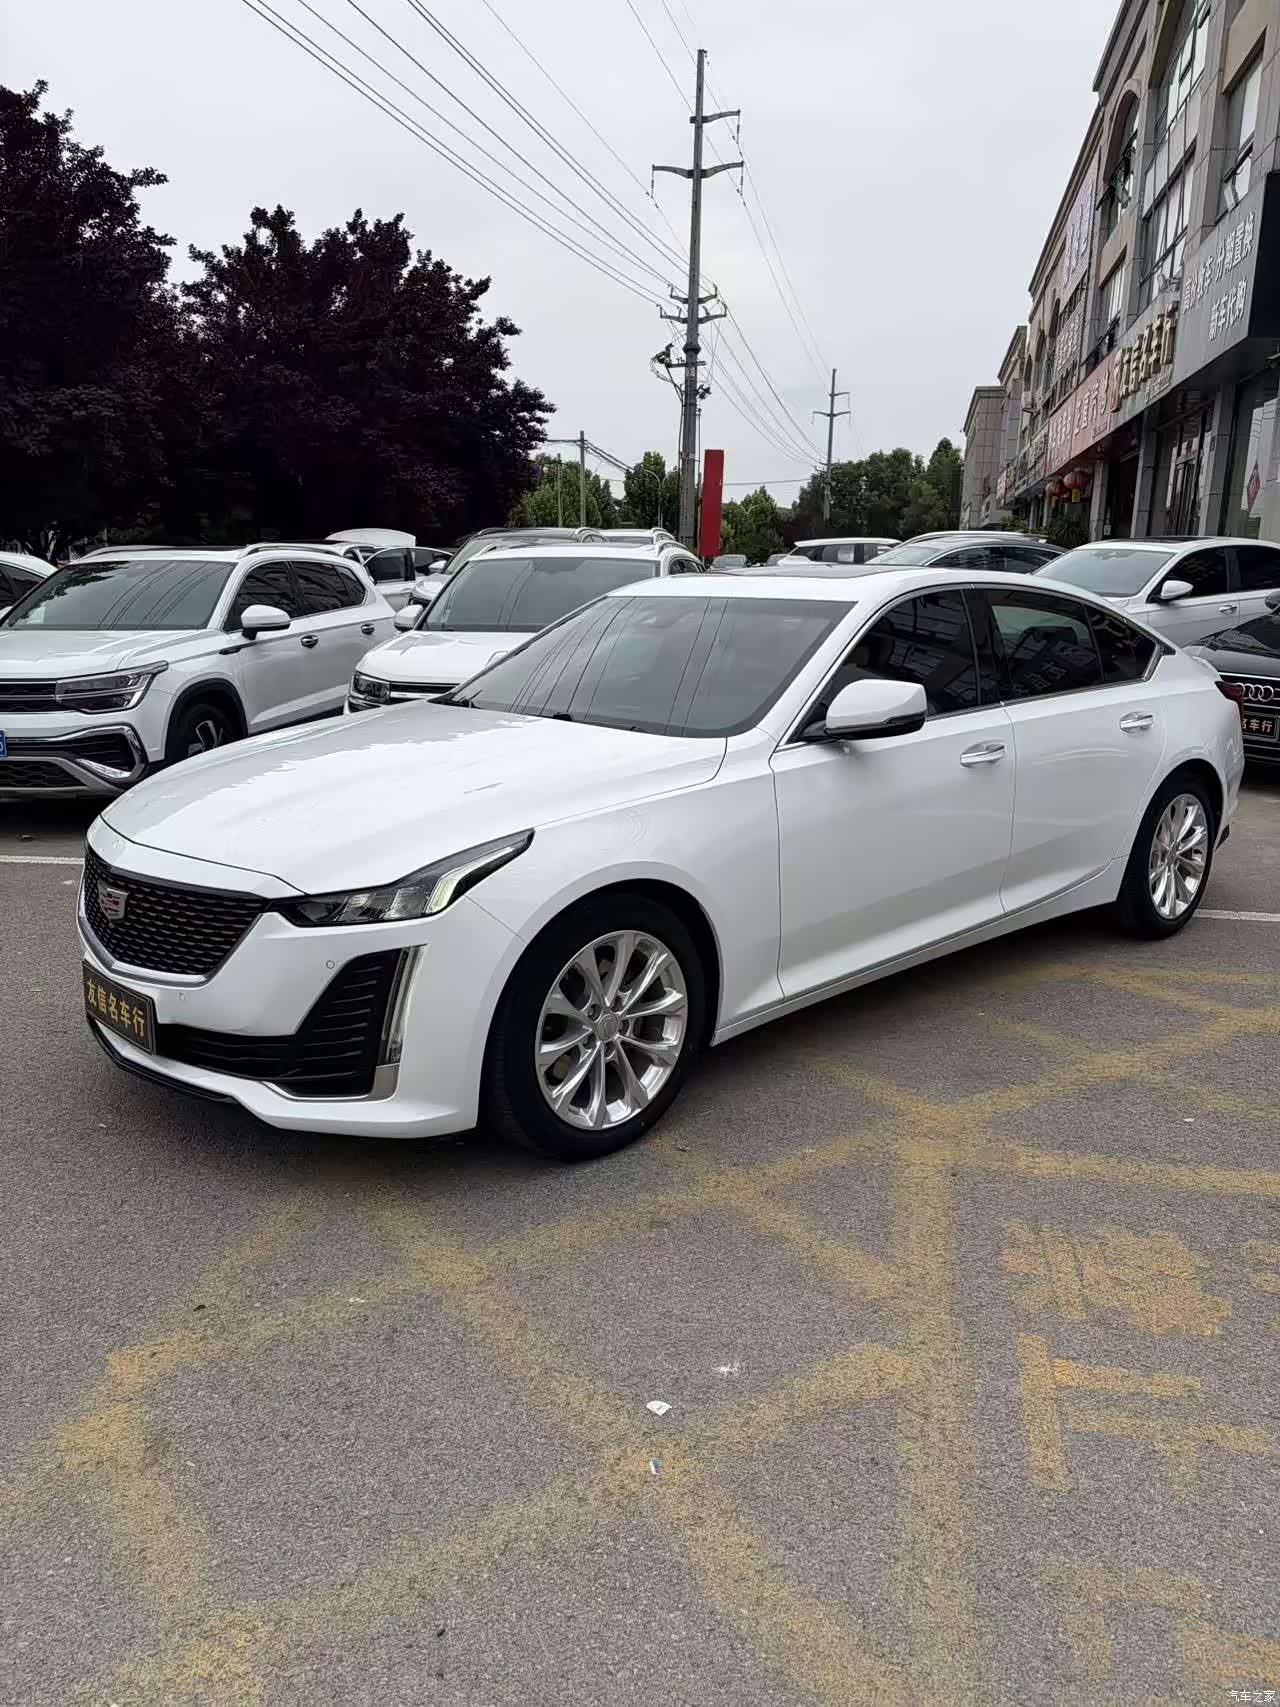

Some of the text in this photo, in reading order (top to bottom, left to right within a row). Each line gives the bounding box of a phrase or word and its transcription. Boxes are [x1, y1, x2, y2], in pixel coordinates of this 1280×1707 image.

[1215, 211, 1255, 282] 分期置换
[1208, 276, 1248, 342] 新车代购
[86, 978, 145, 1037] 友信名车行
